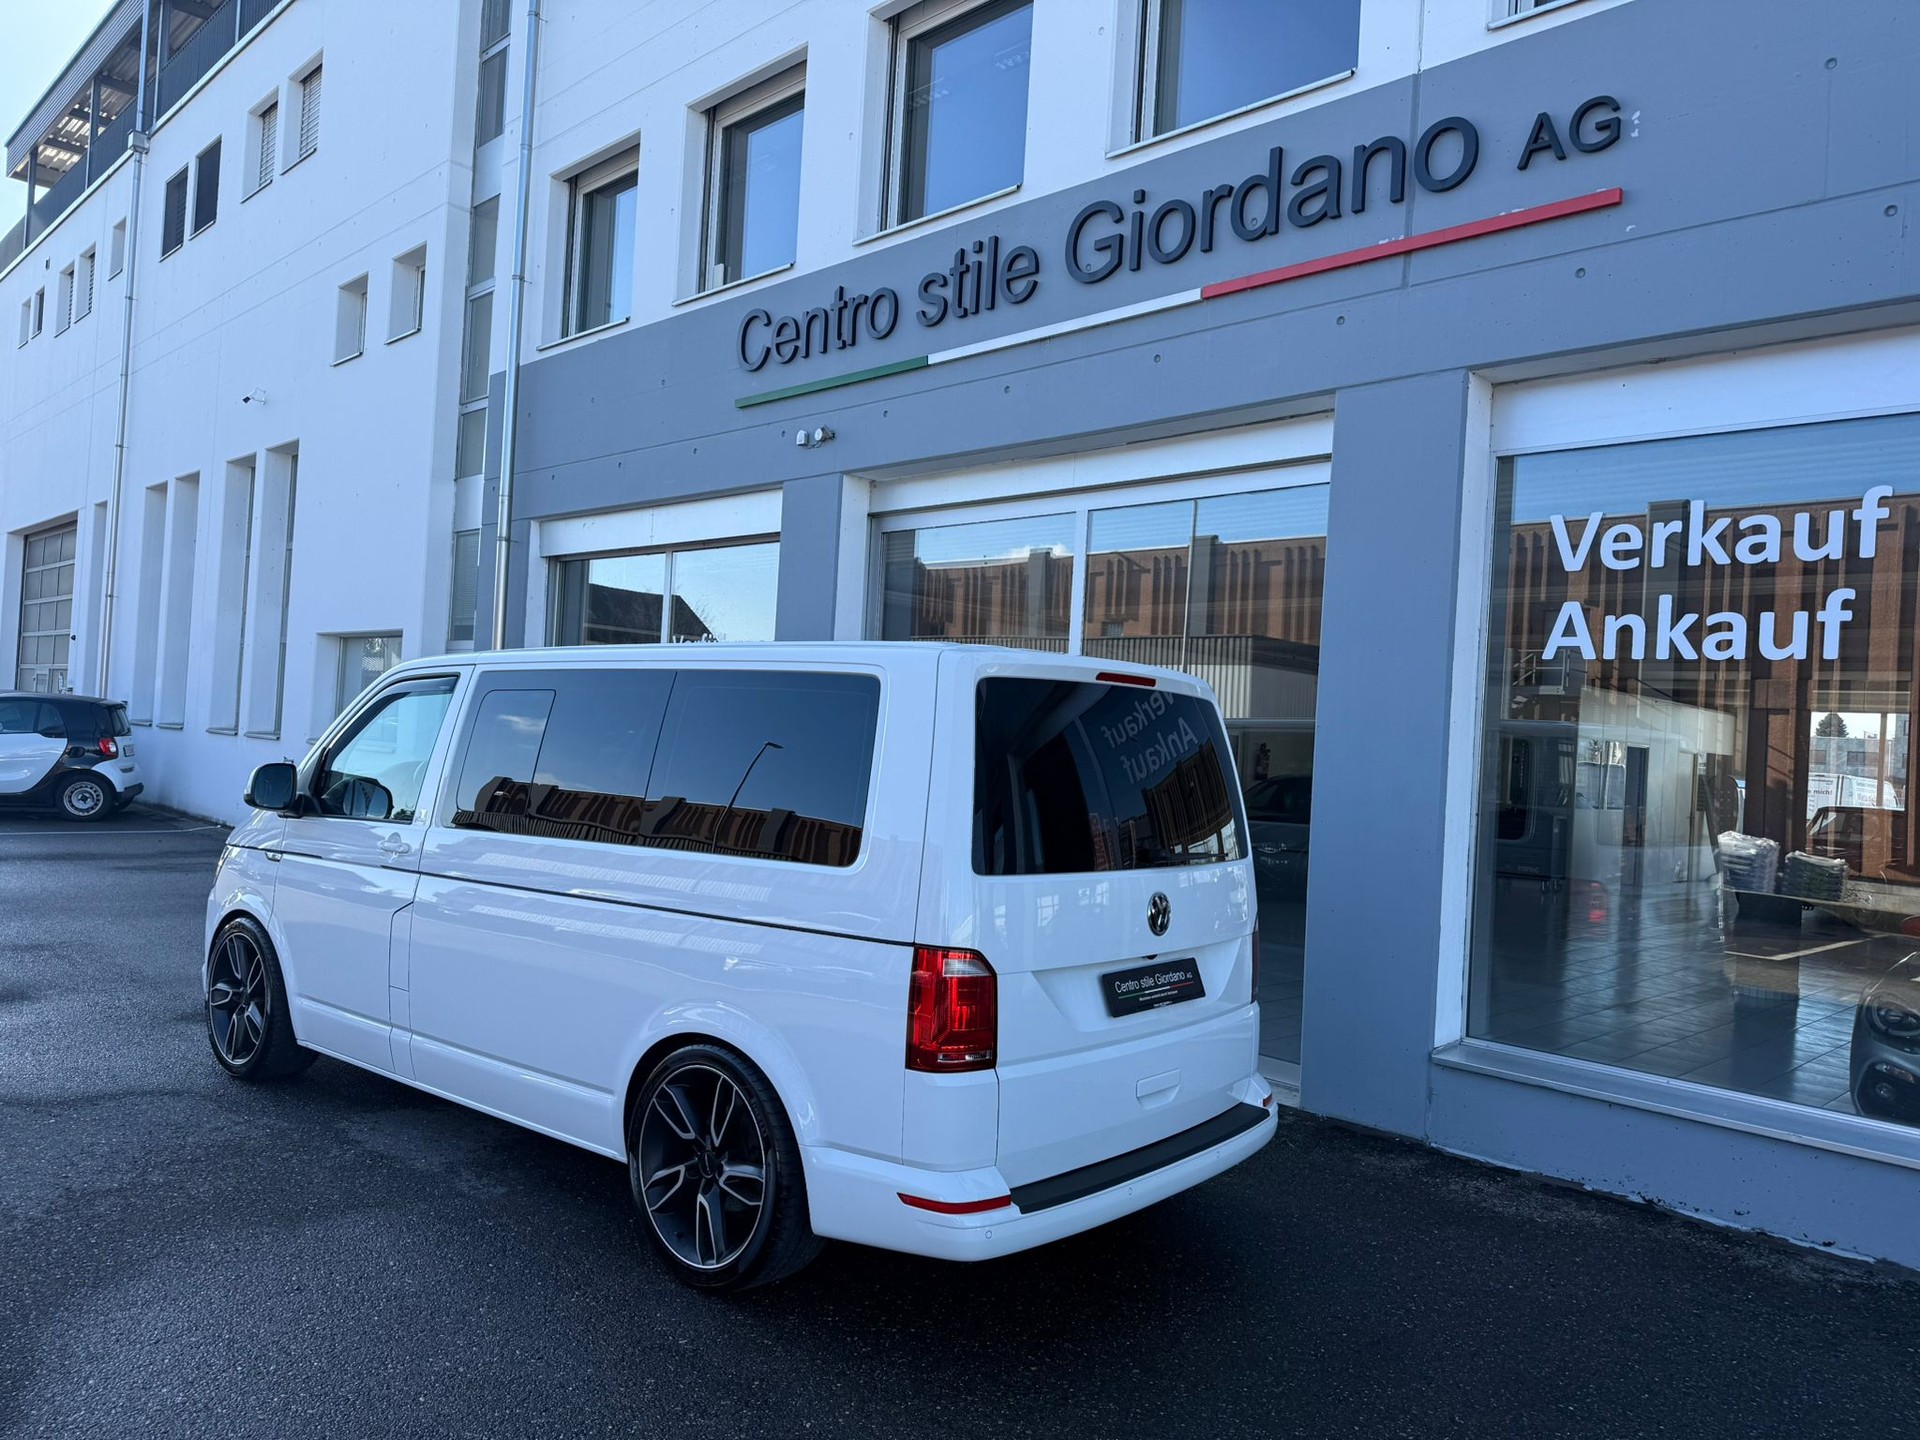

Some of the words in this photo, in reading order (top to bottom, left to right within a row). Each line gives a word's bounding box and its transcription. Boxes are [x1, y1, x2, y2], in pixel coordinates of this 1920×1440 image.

[737, 285, 899, 371] Centro
[916, 235, 1040, 327] stile
[1065, 116, 1480, 284] Giordano
[1517, 95, 1622, 171] AG
[1550, 485, 1893, 572] Verkauf
[1541, 588, 1856, 661] Ankauf
[1115, 979, 1139, 993] Centro
[1140, 975, 1155, 988] stile
[1155, 971, 1185, 985] Giordano
